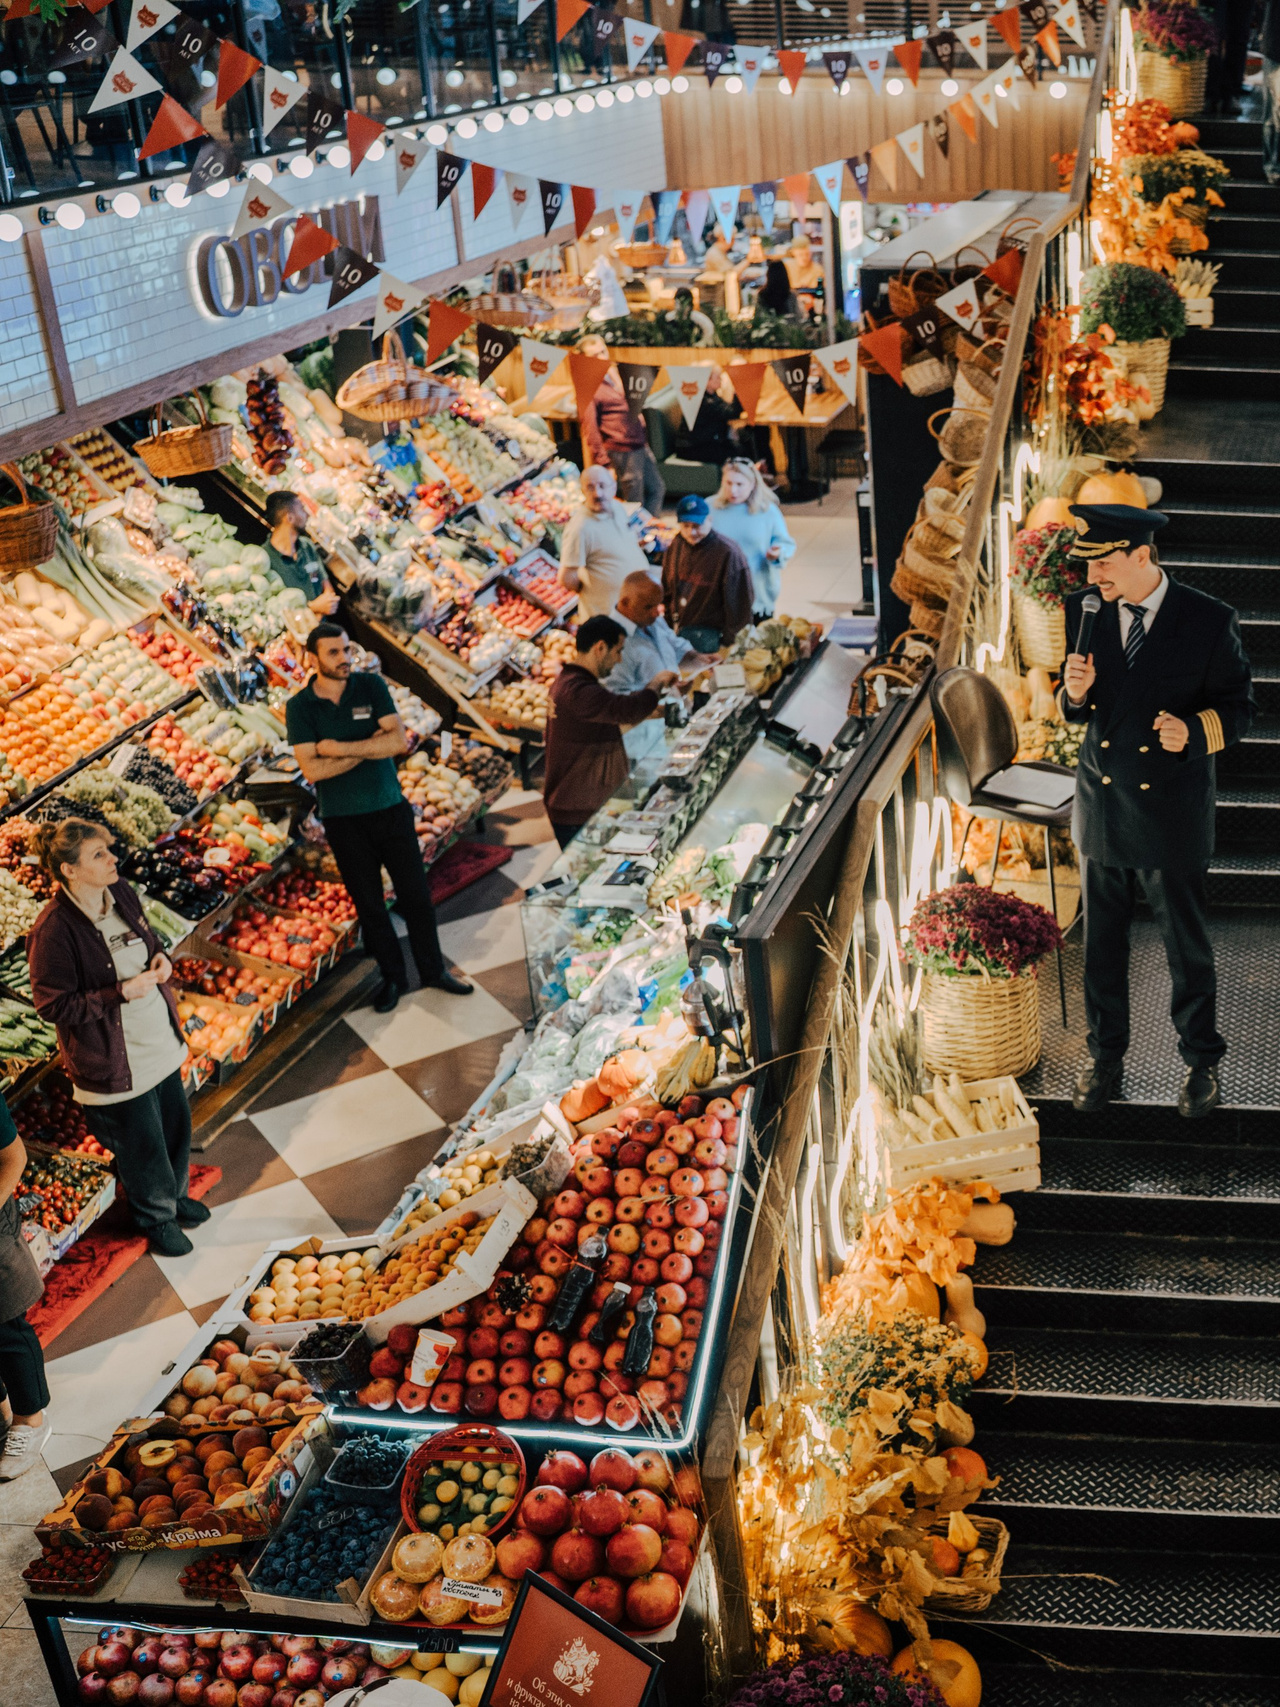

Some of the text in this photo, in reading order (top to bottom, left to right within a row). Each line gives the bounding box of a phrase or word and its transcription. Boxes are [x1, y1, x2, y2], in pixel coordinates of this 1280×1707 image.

[597, 19, 613, 35] 10
[74, 29, 97, 51] 10
[182, 33, 202, 53] 10
[707, 51, 722, 64] 10
[831, 60, 845, 72] 10
[313, 109, 332, 128] 10
[202, 156, 224, 178] 10
[442, 164, 459, 182] 10
[546, 193, 561, 208] 10
[340, 263, 362, 284] 10
[916, 320, 936, 338] 10
[483, 339, 504, 358] 10
[628, 376, 647, 392] 10
[785, 368, 804, 385] 10
[161, 1528, 222, 1545] Крыма
[506, 1677, 514, 1688] и
[532, 1676, 565, 1707] Об этих
